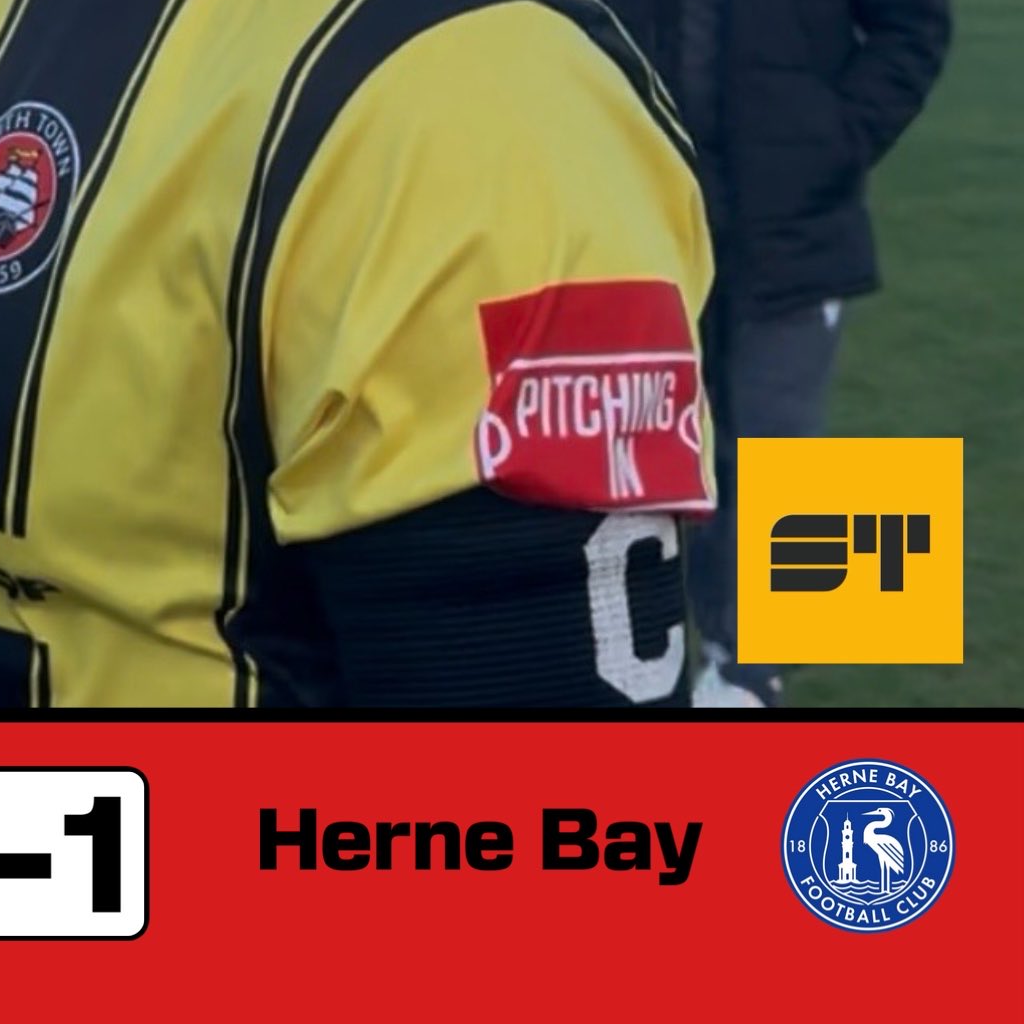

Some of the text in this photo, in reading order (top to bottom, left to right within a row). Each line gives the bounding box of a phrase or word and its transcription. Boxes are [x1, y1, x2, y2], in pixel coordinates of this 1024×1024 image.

[36, 113, 71, 177] TOWN
[515, 370, 677, 438] PITCHING
[605, 432, 645, 500] IN
[583, 512, 684, 704] C
